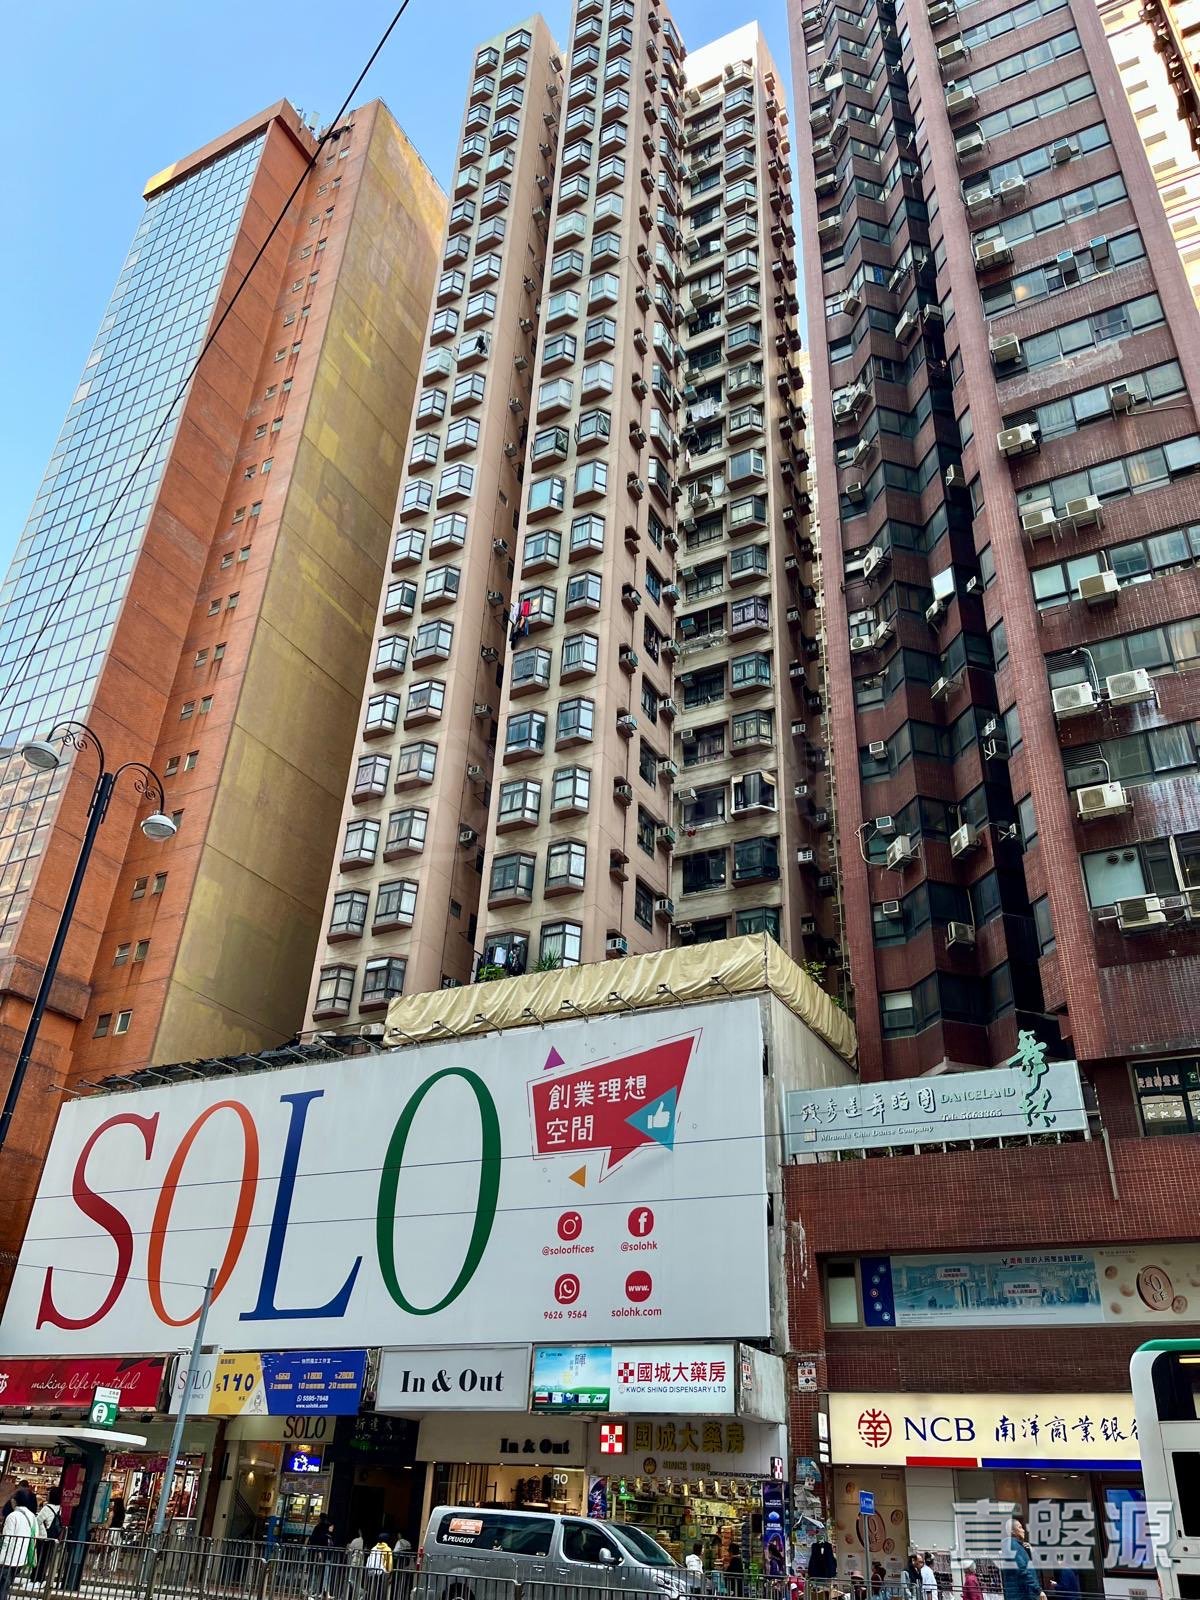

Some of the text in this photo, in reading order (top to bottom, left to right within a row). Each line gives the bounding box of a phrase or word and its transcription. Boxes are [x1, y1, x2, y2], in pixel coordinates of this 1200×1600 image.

[548, 1074, 648, 1112] 創業理想
[940, 1086, 1016, 1104] DANCELAND
[546, 1114, 594, 1145] 空間
[897, 1126, 934, 1137] Company
[36, 1066, 502, 1331] SOLO
[542, 1244, 595, 1257] @solooffices
[620, 1240, 658, 1252] @solohk
[628, 1284, 649, 1292] www.
[543, 1309, 587, 1320] 9626 9564
[611, 1306, 662, 1318] solohk.com
[178, 1370, 212, 1390] SLO
[400, 1368, 504, 1393] In & Out
[636, 1361, 727, 1383] 國城大藥房
[31, 1373, 67, 1399] making
[69, 1372, 89, 1399] life
[626, 1385, 727, 1394] KWOK SHING DISPENSARY LTD
[283, 1416, 327, 1439] SOLO
[904, 1416, 977, 1442] NCB
[500, 1438, 570, 1454] In & Out
[633, 1422, 745, 1454] 國城大藥房
[553, 1473, 569, 1485] 90
[447, 1535, 476, 1544] PEUGEOT
